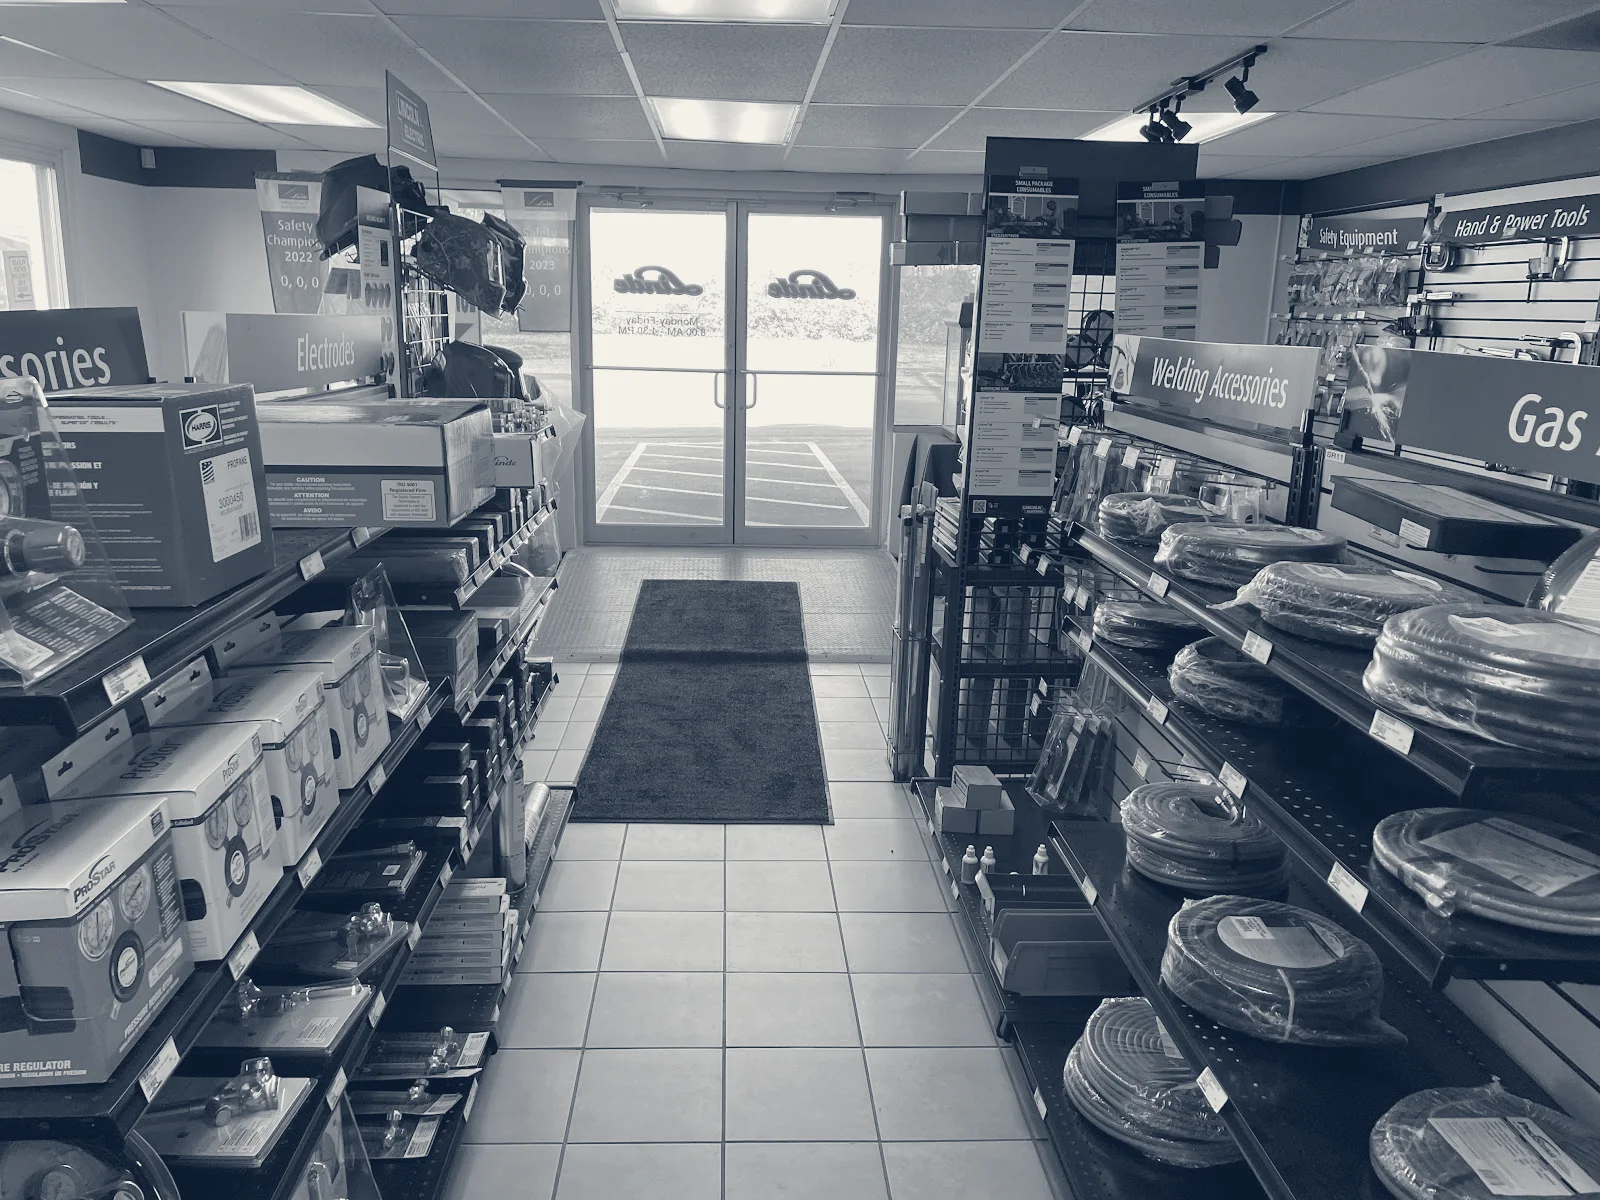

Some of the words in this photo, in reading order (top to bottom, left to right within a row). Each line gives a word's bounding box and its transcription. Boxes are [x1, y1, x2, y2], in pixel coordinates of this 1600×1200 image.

[277, 218, 314, 234] Safety
[1454, 214, 1491, 237] Hand
[1490, 216, 1501, 233] &
[1505, 211, 1547, 233] Power
[1550, 204, 1591, 228] Tools
[266, 234, 323, 250] Champion
[1319, 228, 1338, 246] Safety
[1339, 229, 1398, 249] Equipment
[284, 251, 313, 263] 2022
[525, 246, 571, 257] ampions
[529, 260, 555, 270] 2023
[280, 275, 293, 289] 0,
[296, 276, 308, 290] 0,
[311, 276, 319, 289] 0
[539, 284, 551, 298] 0,
[554, 284, 561, 296] 0
[297, 331, 356, 372] Electrodes
[1151, 356, 1210, 404] Welding
[1208, 364, 1289, 409] Accessories
[190, 421, 212, 432] HARRIS
[1508, 393, 1589, 451] Gas
[226, 455, 248, 470] PROPANE
[1326, 450, 1344, 461] SR11
[93, 461, 103, 470] ET
[217, 490, 244, 510] 3000450
[13, 1060, 72, 1072] REGULATOR
